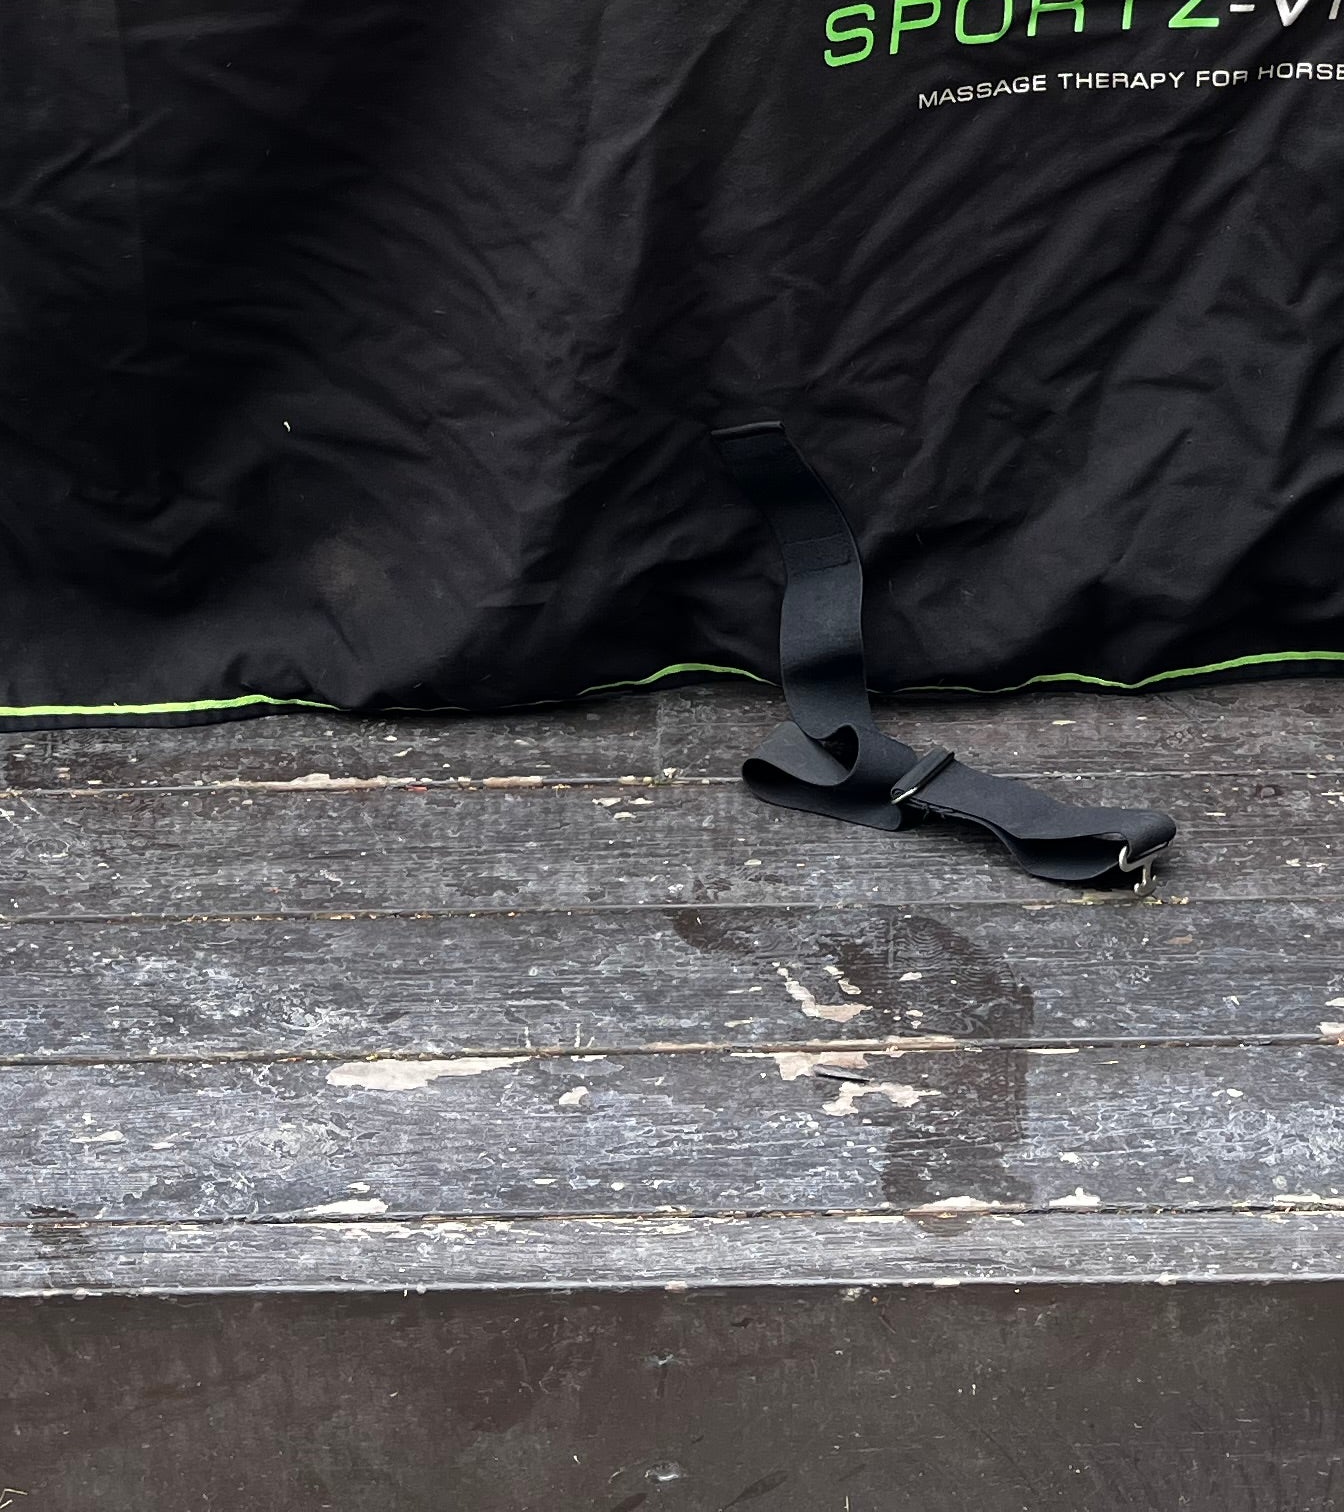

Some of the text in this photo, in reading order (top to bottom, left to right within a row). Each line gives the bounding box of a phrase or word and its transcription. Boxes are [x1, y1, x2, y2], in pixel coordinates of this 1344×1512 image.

[917, 74, 1048, 110] MASSAGE
[1058, 71, 1184, 90] THERAPY
[1195, 68, 1250, 86] FOR
